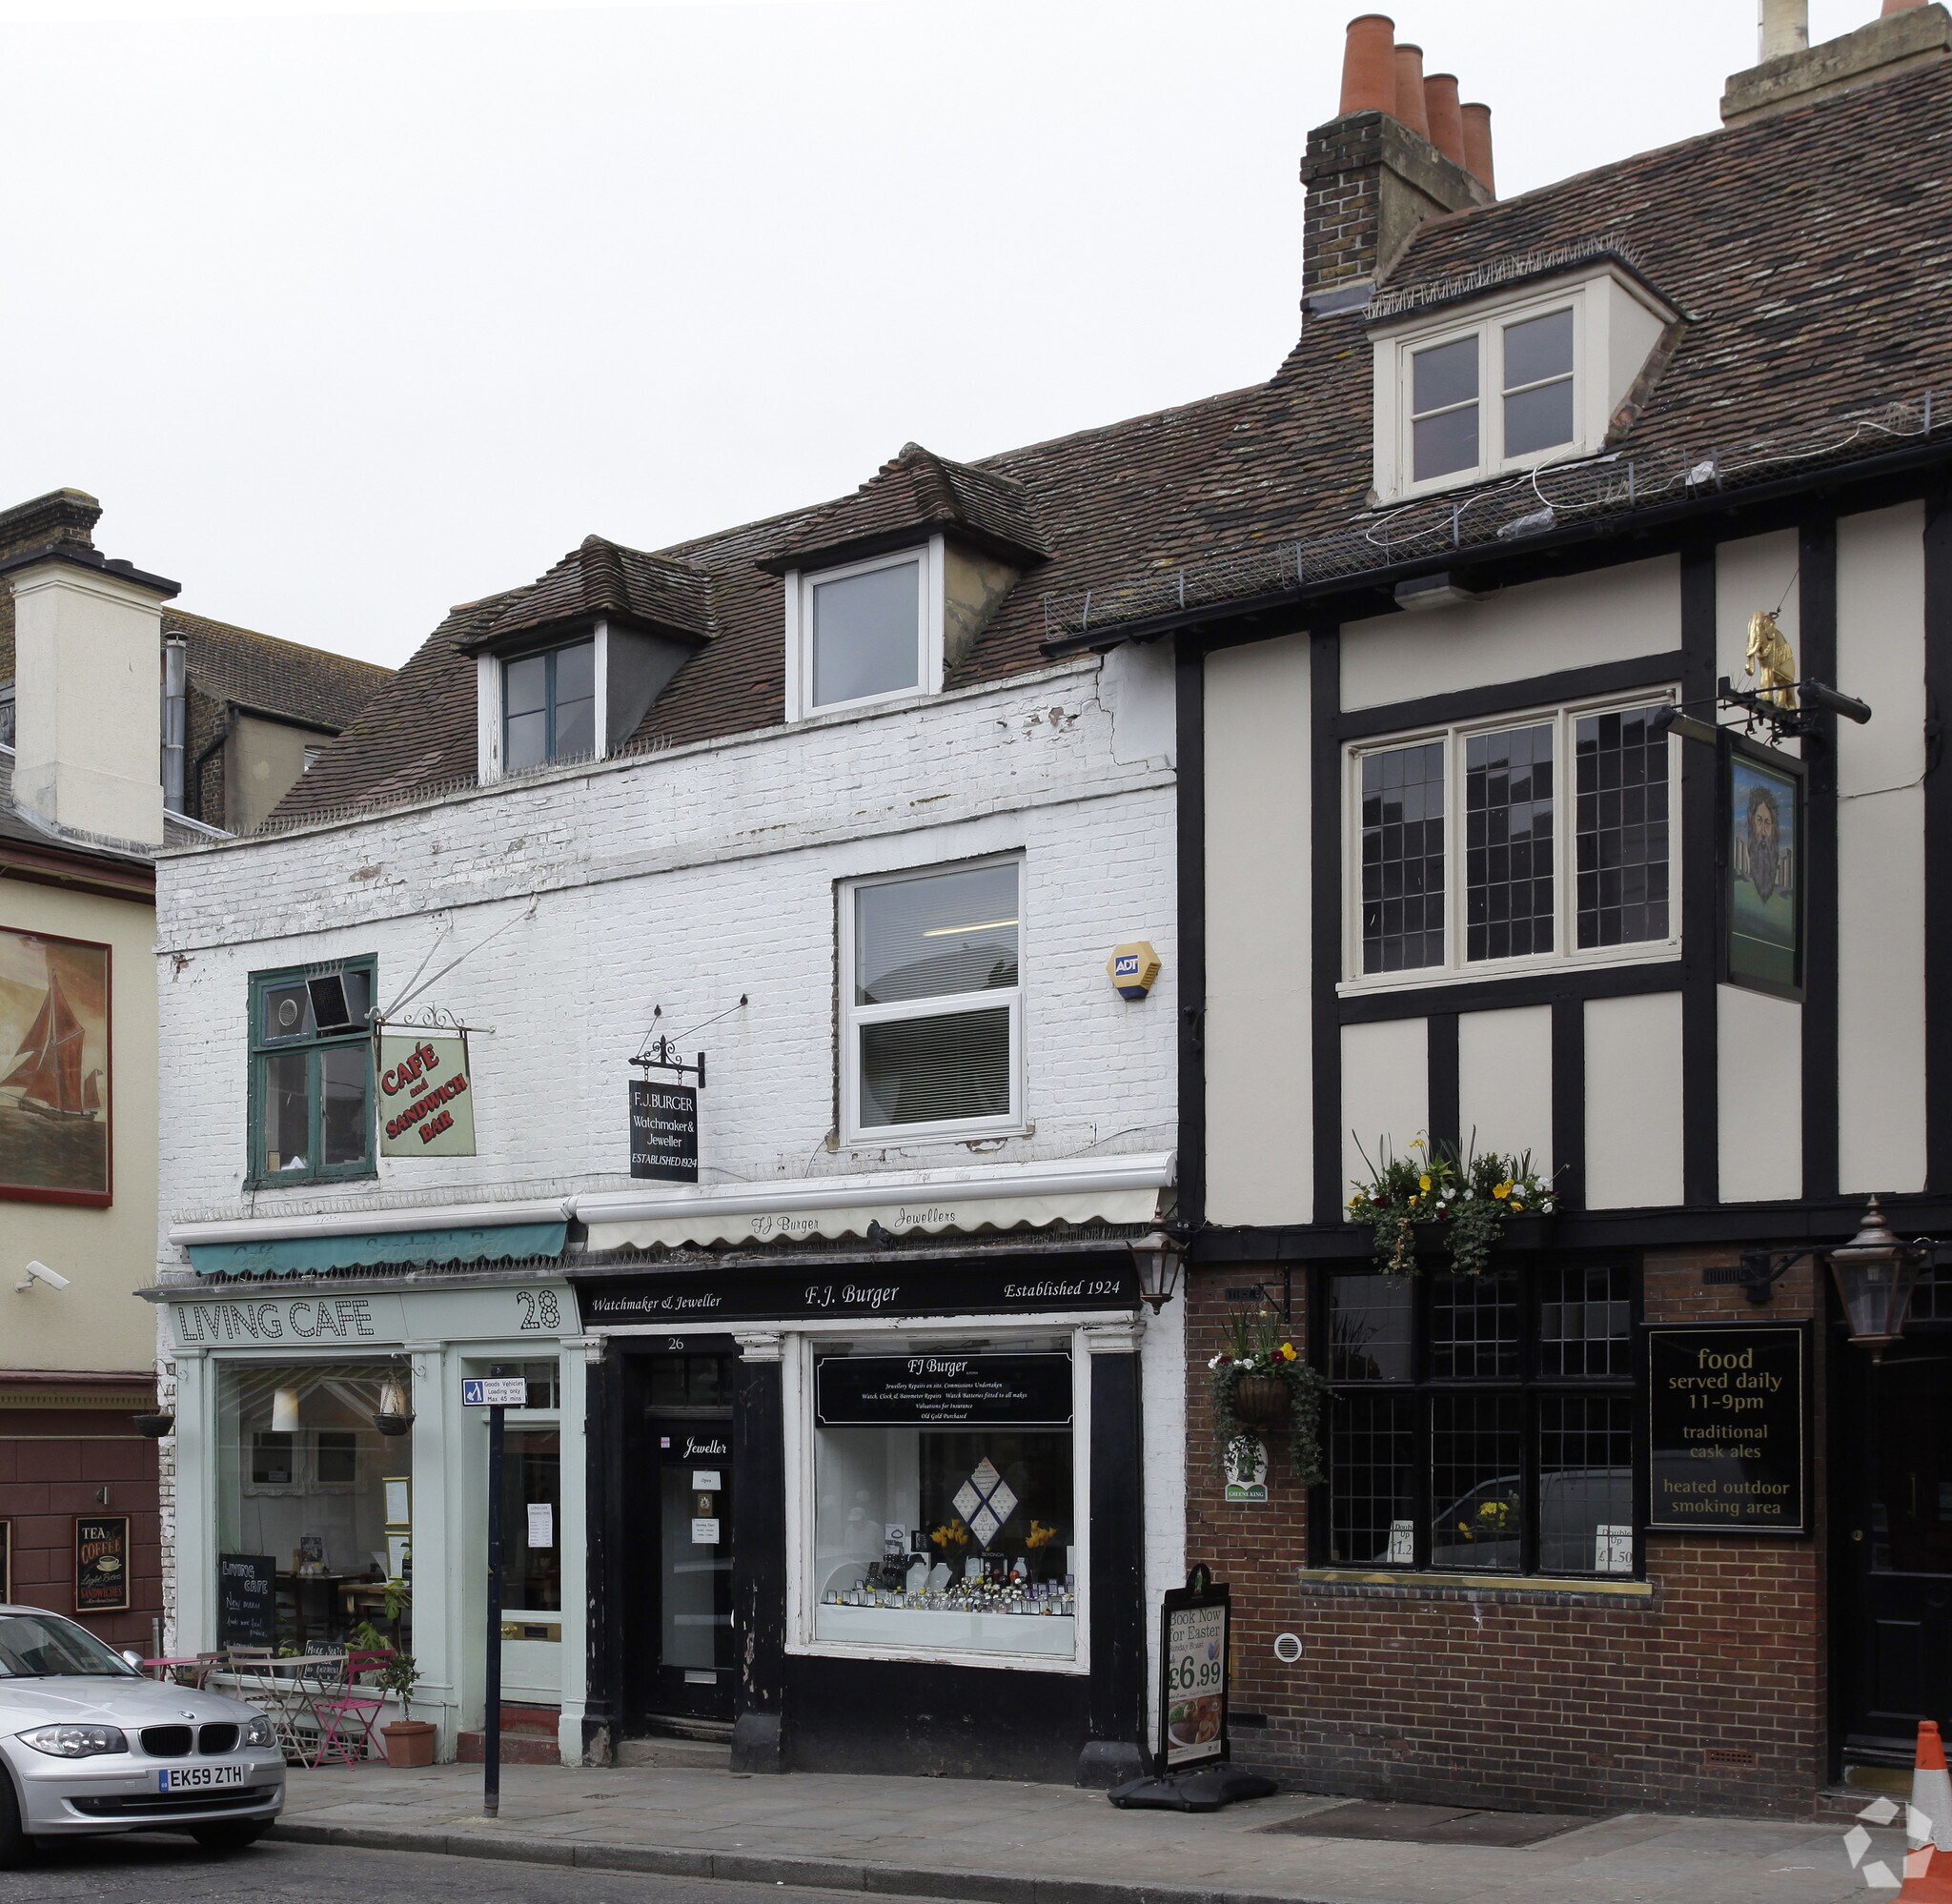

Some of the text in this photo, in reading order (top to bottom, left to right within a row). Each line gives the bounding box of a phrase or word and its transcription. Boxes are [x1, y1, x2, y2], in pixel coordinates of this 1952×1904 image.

[1115, 959, 1138, 972] ADT
[410, 1077, 429, 1098] and
[386, 1073, 467, 1140] SANDWICH
[418, 1110, 454, 1144] BAR
[647, 1133, 681, 1147] Jeweller
[632, 1153, 698, 1168] ESTABLISHED 1924
[776, 1216, 819, 1235] Burger
[894, 1207, 956, 1227] Jewellers
[234, 1230, 506, 1267] Café Sandwich Bar
[592, 1295, 658, 1312] Watchmaker
[661, 1296, 673, 1309] &
[675, 1293, 722, 1310] Jeweller
[842, 1284, 900, 1308] Burger
[1004, 1280, 1086, 1298] Established
[1088, 1280, 1120, 1295] 1924
[178, 1289, 561, 1341] LIVING CAFE 28
[668, 1337, 684, 1350] 26
[1698, 1347, 1753, 1369] food
[907, 1358, 967, 1378] FJ Burger
[884, 1382, 907, 1390] Jewellery
[1669, 1372, 1782, 1392] served daily
[1689, 1394, 1764, 1413] 11-9pm
[1683, 1425, 1768, 1439] traditional
[682, 1435, 726, 1458] Jeweller
[1690, 1444, 1761, 1458] cask ales
[1663, 1479, 1790, 1495] heated outdoor
[1672, 1499, 1780, 1517] smoking area
[82, 1527, 106, 1540] TEA
[1401, 1530, 1411, 1540] Up
[1611, 1536, 1622, 1546] Up
[81, 1536, 121, 1564] COFFEE
[1597, 1546, 1632, 1563] £1.50
[222, 1560, 255, 1579] LIVING
[80, 1585, 123, 1599] SANDWICHES
[244, 1579, 269, 1594] CAFE
[226, 1591, 241, 1609] New
[1199, 1608, 1221, 1623] Now
[1188, 1624, 1220, 1640] Easter
[1169, 1655, 1220, 1691] £6.99
[172, 1766, 242, 1787] EK59 ZTH
